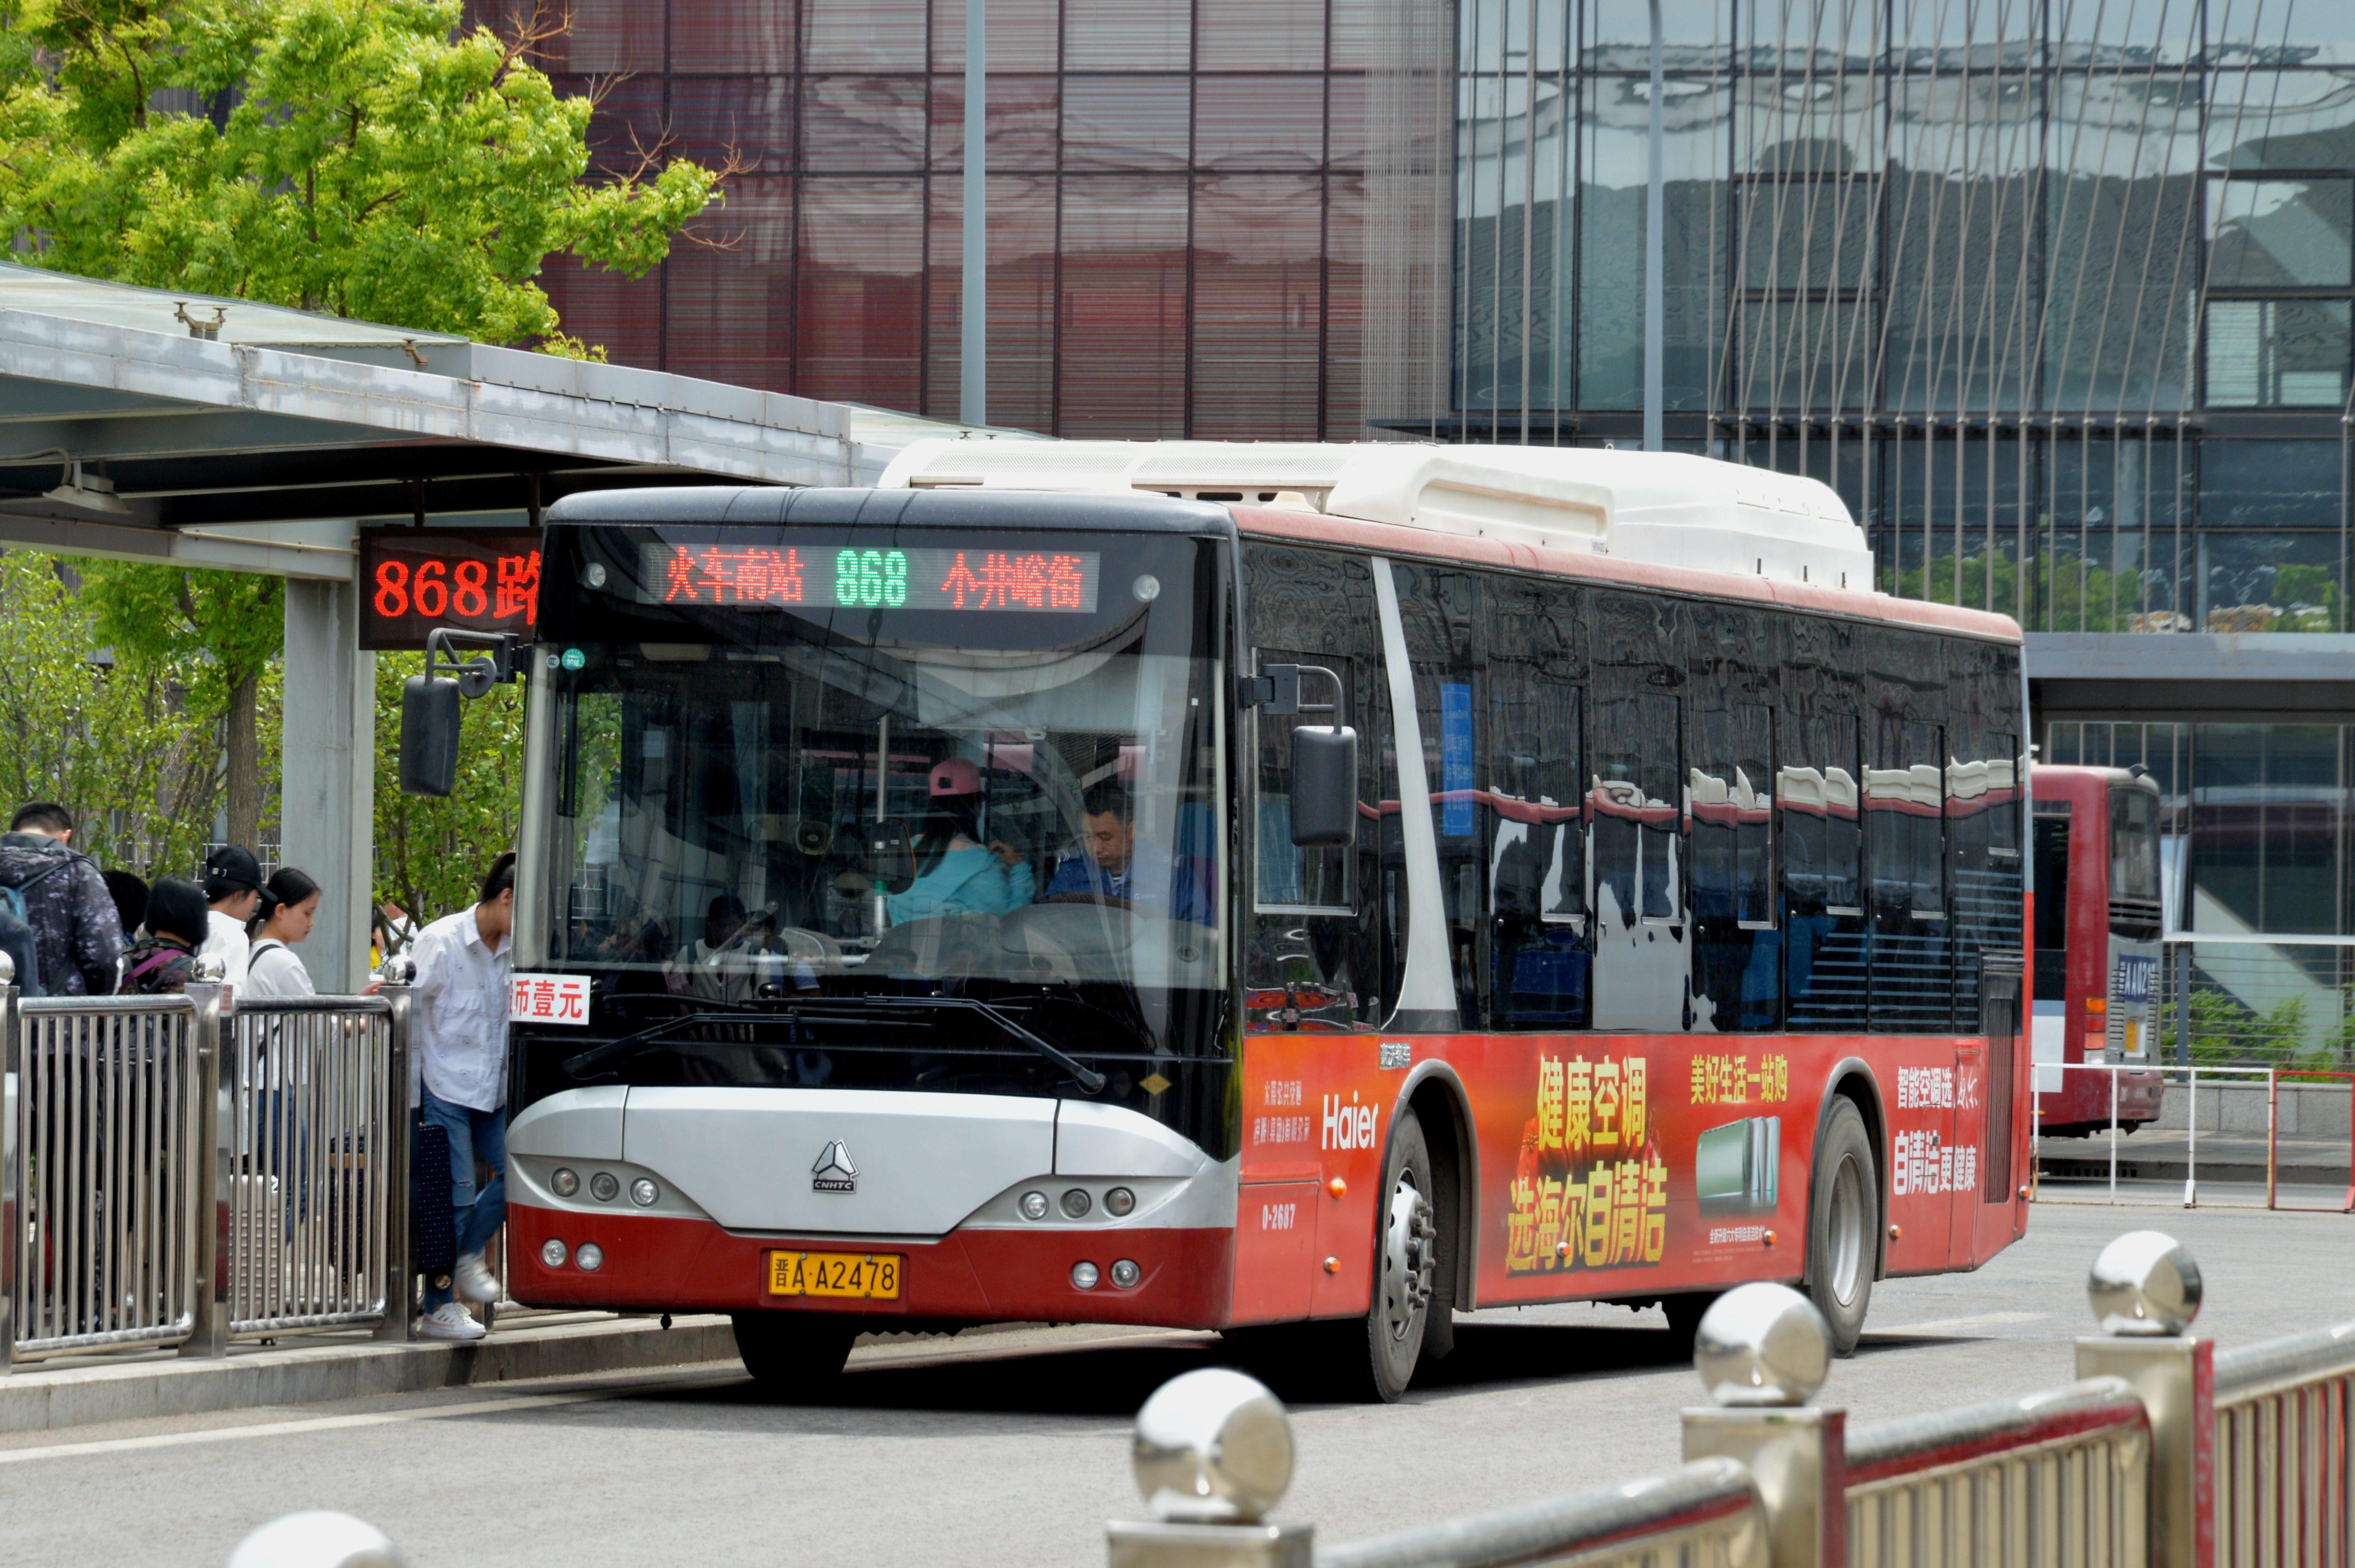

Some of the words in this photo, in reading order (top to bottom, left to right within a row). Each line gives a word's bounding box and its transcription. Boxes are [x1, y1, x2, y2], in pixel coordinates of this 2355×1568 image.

[374, 551, 541, 625] 868路
[666, 546, 804, 602] 火车南站
[836, 550, 907, 606] 868
[509, 979, 582, 1018] 币壹元
[1537, 1055, 1646, 1151] 健康空调
[1691, 1053, 1788, 1105] 美好生活一站购
[1322, 1090, 1378, 1150] Haier
[1894, 1130, 1976, 1195] 自清洁更健康
[1506, 1158, 1667, 1271] 选海尔自清洁
